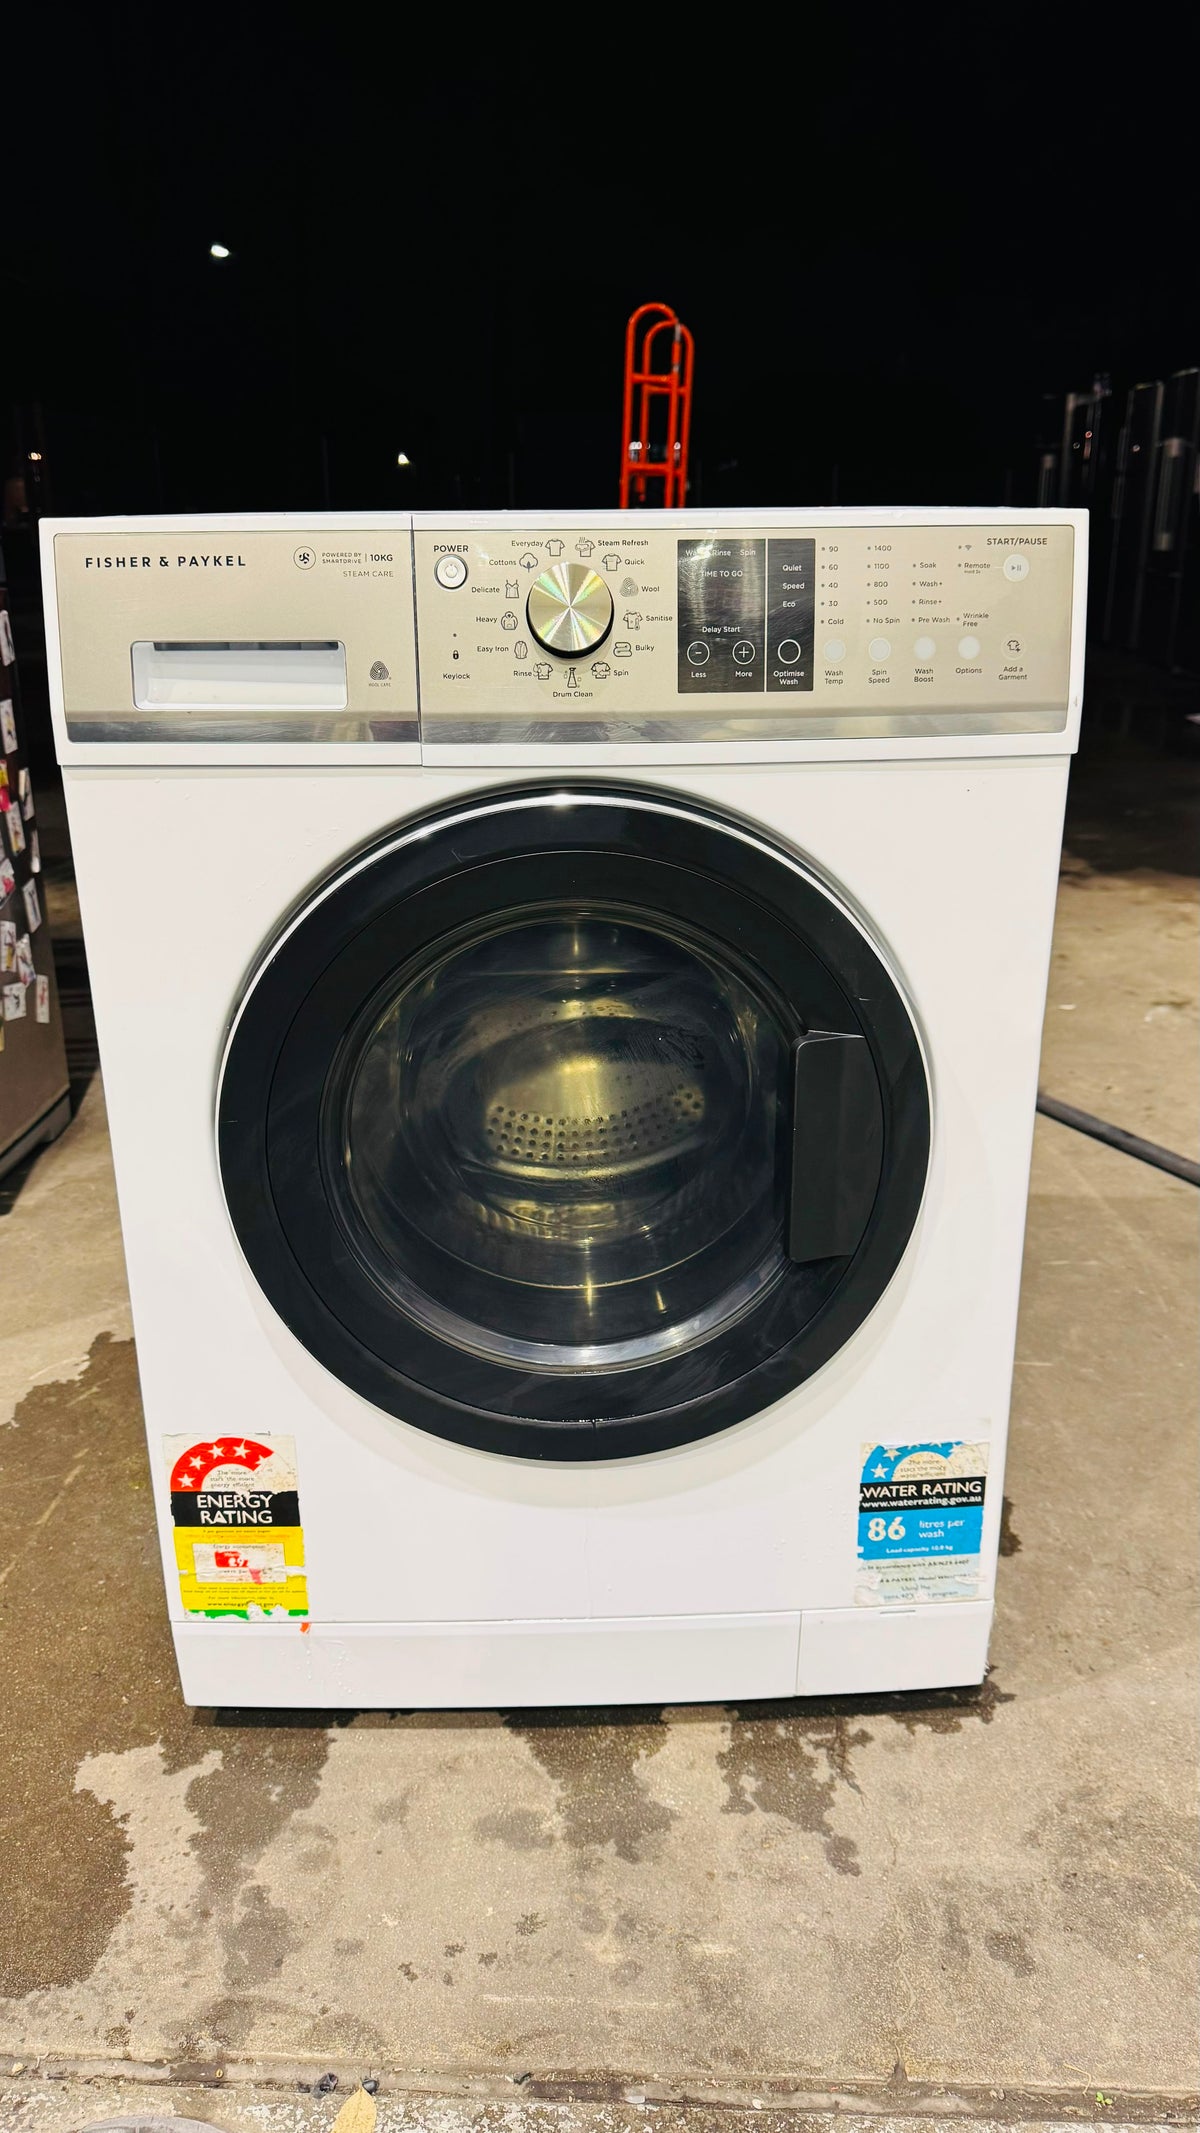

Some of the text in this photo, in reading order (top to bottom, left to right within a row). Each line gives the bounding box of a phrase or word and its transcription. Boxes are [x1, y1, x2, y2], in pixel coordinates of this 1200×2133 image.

[511, 540, 544, 548] Everyday
[597, 539, 649, 547] Steam Refresh
[987, 537, 1048, 546] START/PAUSE
[433, 544, 469, 553] POWER
[829, 545, 839, 553] 90
[711, 549, 732, 557] Rinse
[739, 549, 756, 558] Spin
[85, 555, 247, 569] FISHER & PAYKEL
[370, 554, 393, 562] 10KG
[624, 558, 645, 567] Quick
[919, 561, 937, 569] Soak
[782, 564, 802, 573] Quiet
[828, 563, 839, 571] 60
[343, 570, 394, 578] STEAM CARE
[701, 570, 718, 578] TIME
[641, 585, 660, 593] Wool
[782, 582, 805, 591] Speed
[782, 600, 796, 608] Eco
[475, 616, 498, 624] Heavy
[645, 614, 673, 622] Sanitise
[884, 617, 901, 625] Spin
[918, 616, 929, 624] Pre
[701, 625, 741, 634] Delay Start
[476, 646, 493, 654] Easy
[635, 644, 655, 652] Bulky
[513, 669, 533, 677] Rinse
[613, 669, 629, 677] Spin
[824, 669, 844, 677] Wash
[871, 669, 888, 677] Spin
[914, 667, 934, 675] Wash
[955, 667, 983, 675] Options
[1003, 665, 1018, 673] Add
[443, 672, 471, 680] Keylock
[735, 670, 753, 678] More
[773, 670, 805, 679] Optimise
[825, 678, 844, 686] Temp
[868, 676, 890, 684] Speed
[552, 690, 594, 698] Drum Clean
[863, 1480, 982, 1499] WATER RATING
[196, 1494, 273, 1509] ENERGY
[862, 1496, 982, 1508] www.waterrating.gov.au
[200, 1510, 273, 1525] RATING
[919, 1519, 965, 1529] litres per
[868, 1517, 906, 1541] 86
[919, 1529, 945, 1538] wash
